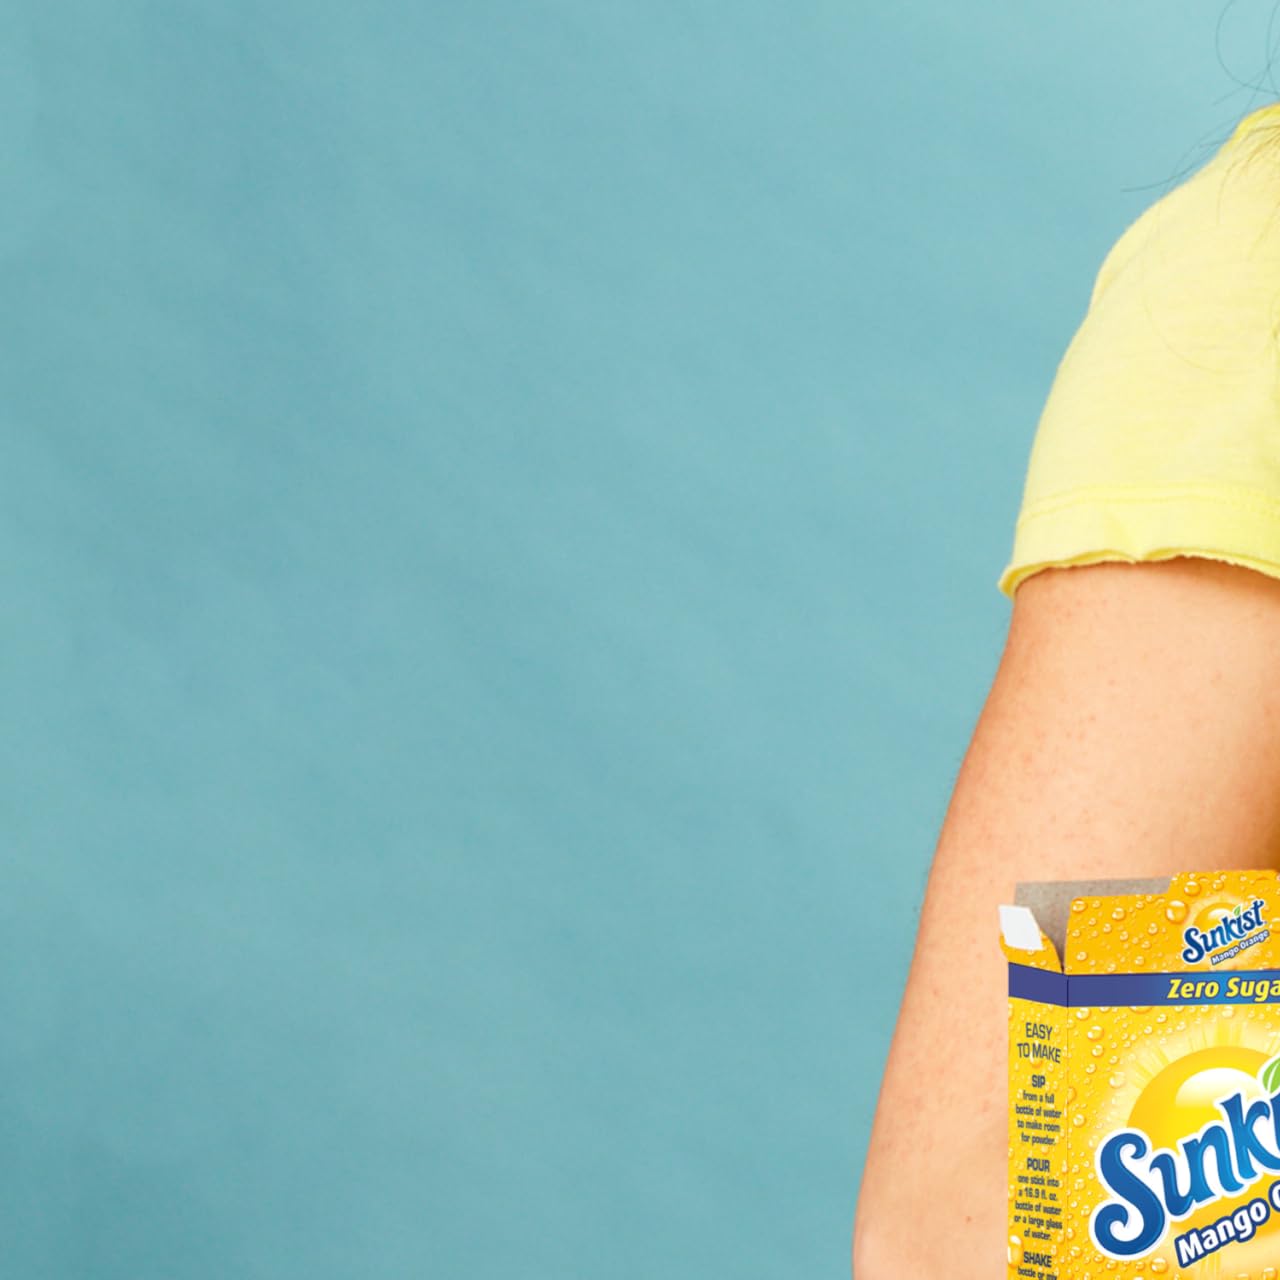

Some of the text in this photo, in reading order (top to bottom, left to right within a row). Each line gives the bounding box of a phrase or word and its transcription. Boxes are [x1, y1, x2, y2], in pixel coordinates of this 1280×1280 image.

[1182, 899, 1265, 963] Sunkist
[1210, 930, 1270, 965] Mango Orange
[1166, 978, 1220, 999] Zero
[1025, 1022, 1053, 1040] EASY
[1016, 1043, 1062, 1063] TO MAKE
[1031, 1075, 1046, 1088] SIP
[1022, 1091, 1037, 1102] from
[1015, 1104, 1062, 1119] bottle of water
[1017, 1120, 1024, 1128] to
[1027, 1158, 1050, 1172] POUR
[1017, 1176, 1029, 1184] one
[1024, 1188, 1040, 1199] 16.9
[1015, 1201, 1062, 1215] bottle of water
[1028, 1216, 1044, 1228] large
[1023, 1229, 1030, 1238] of
[1176, 1200, 1269, 1267] Mango
[1023, 1252, 1052, 1268] SHAKE
